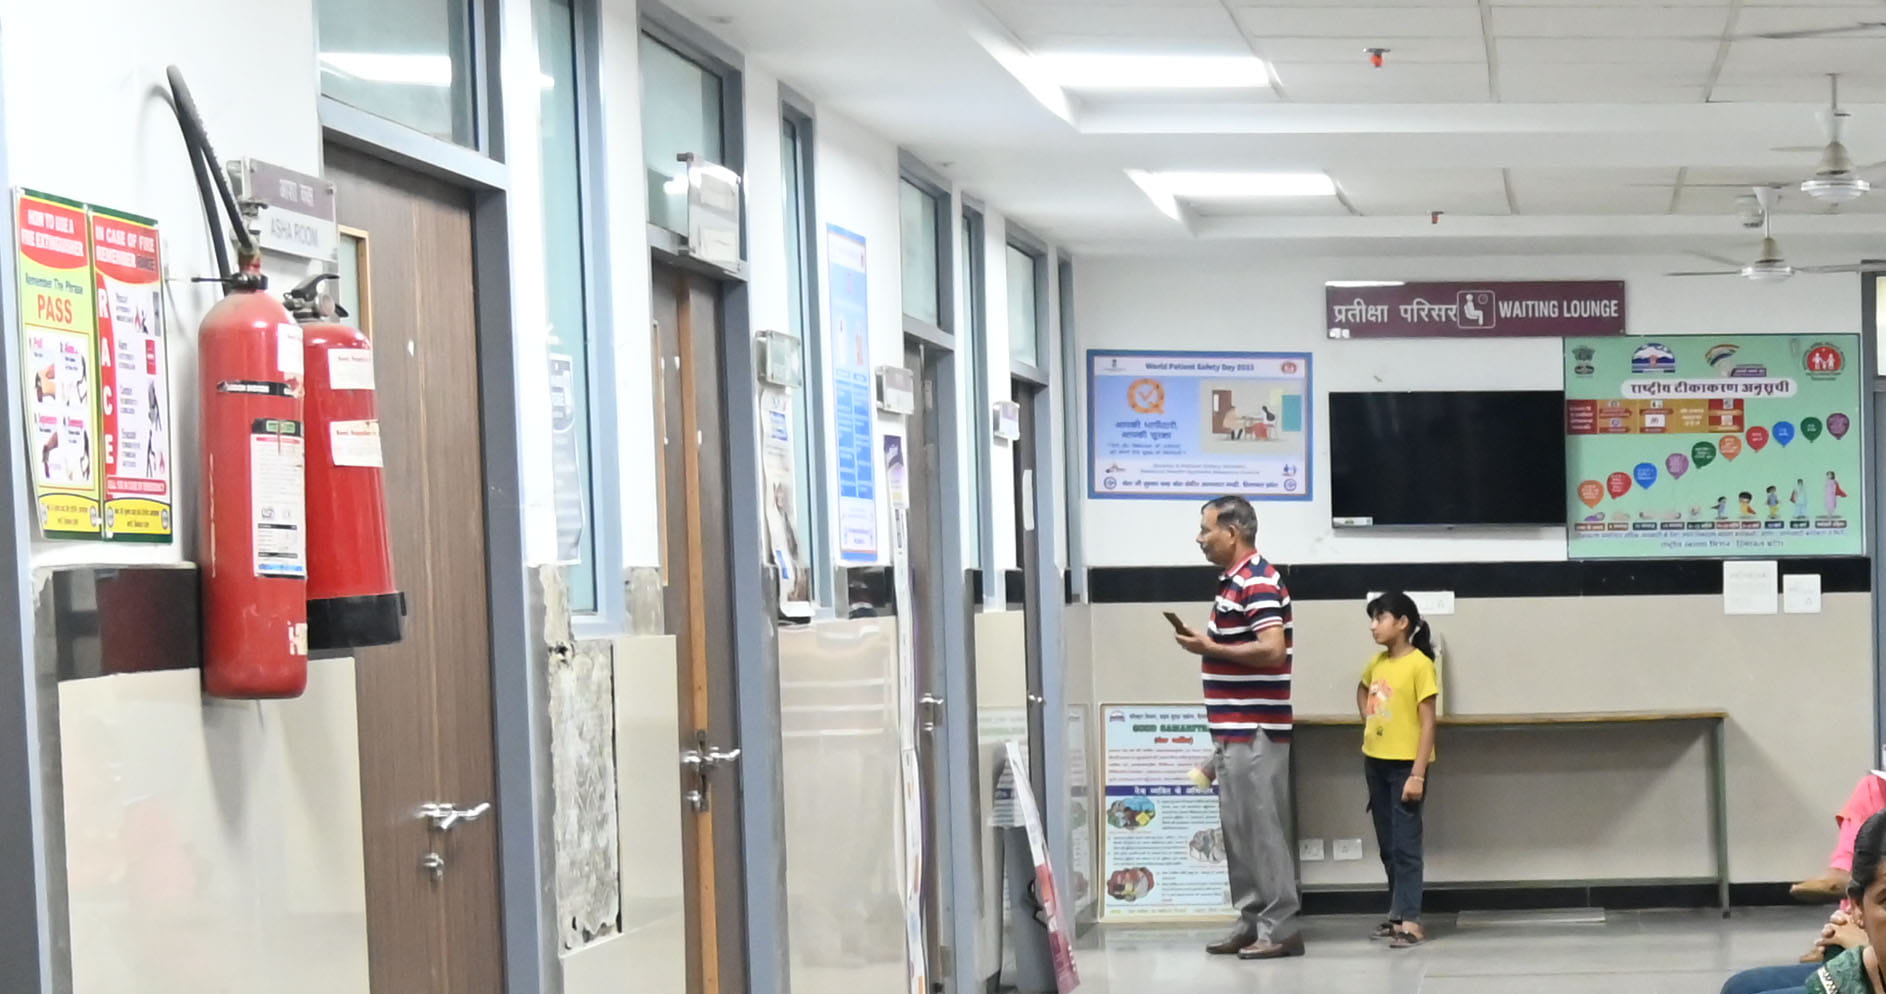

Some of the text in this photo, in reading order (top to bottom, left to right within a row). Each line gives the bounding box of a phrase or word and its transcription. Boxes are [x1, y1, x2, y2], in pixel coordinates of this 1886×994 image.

[106, 228, 126, 246] CASE
[37, 294, 72, 324] PASS
[1333, 298, 1457, 324] प्रतीक्षा परिसर
[1499, 299, 1619, 319] WAITING LOUNGE
[1145, 362, 1168, 370] World
[1197, 363, 1220, 372] Safety
[1221, 363, 1235, 372] Day
[1631, 381, 1671, 395] राष्ट्रीय
[1675, 380, 1738, 394] टीकाकरण
